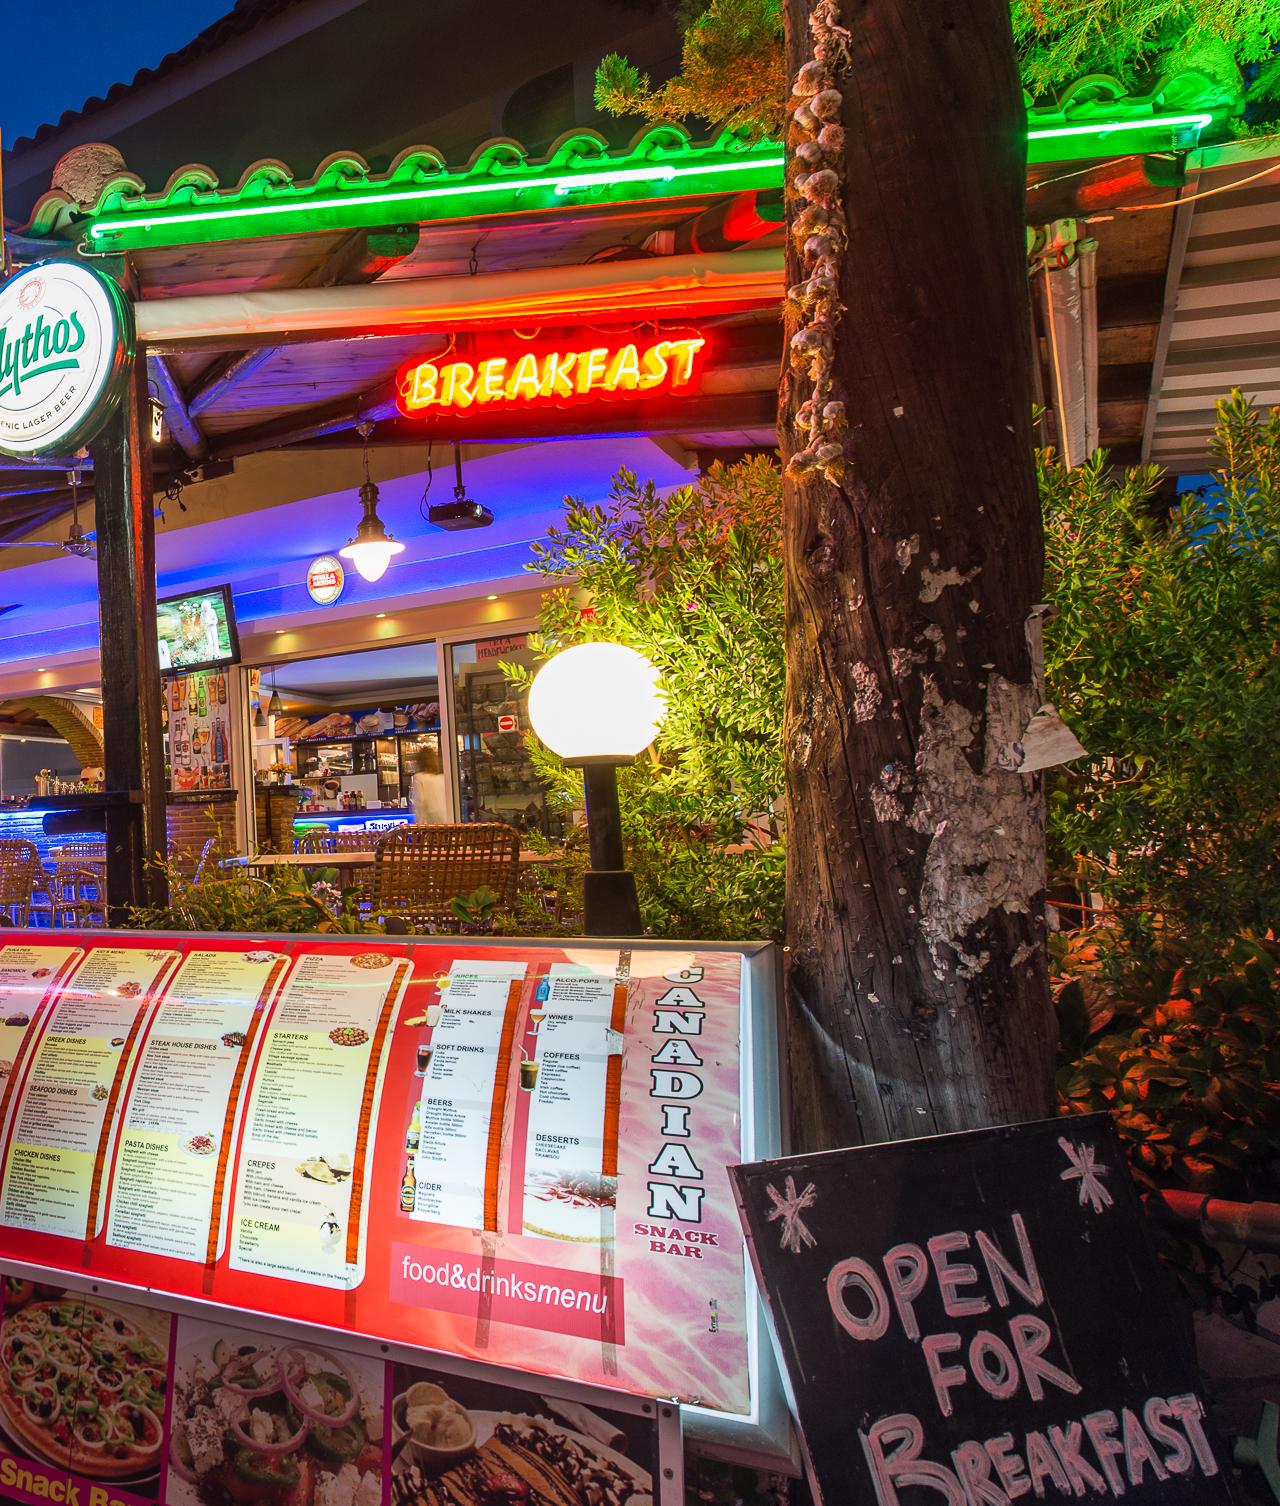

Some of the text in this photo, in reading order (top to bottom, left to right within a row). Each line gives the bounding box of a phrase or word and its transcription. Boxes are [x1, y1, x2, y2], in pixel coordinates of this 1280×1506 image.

[410, 337, 705, 408] BREAKFAST
[22, 411, 53, 430] LAGER
[54, 385, 77, 412] BEER
[46, 1036, 87, 1045] GREEK DISHES
[273, 1033, 309, 1041] STARTERS
[150, 1039, 217, 1051] STEAK HOUSE DISHES
[456, 1045, 485, 1053] DRINKS
[543, 1052, 580, 1061] COFFEES
[29, 1085, 78, 1096] SEAFOOD DISHES
[647, 964, 705, 1224] CANADIAN
[427, 1098, 453, 1107] BEERS
[535, 1133, 580, 1145] DESSERTS
[124, 1140, 169, 1152] PASTA DISHES
[14, 1149, 61, 1162] CHICKEN DISHES
[247, 1159, 276, 1170] CREPES
[418, 1182, 442, 1191] CIDER
[240, 1218, 280, 1232] ICE CREAM
[633, 1222, 719, 1246] SNACK
[648, 1239, 704, 1259] BAR
[826, 1211, 1045, 1342] OPEN
[401, 1256, 608, 1314] food&drinksmenu
[921, 1313, 1083, 1417] FOR
[858, 1392, 1219, 1506] BREAKFAST
[0, 1457, 81, 1506] Snack
